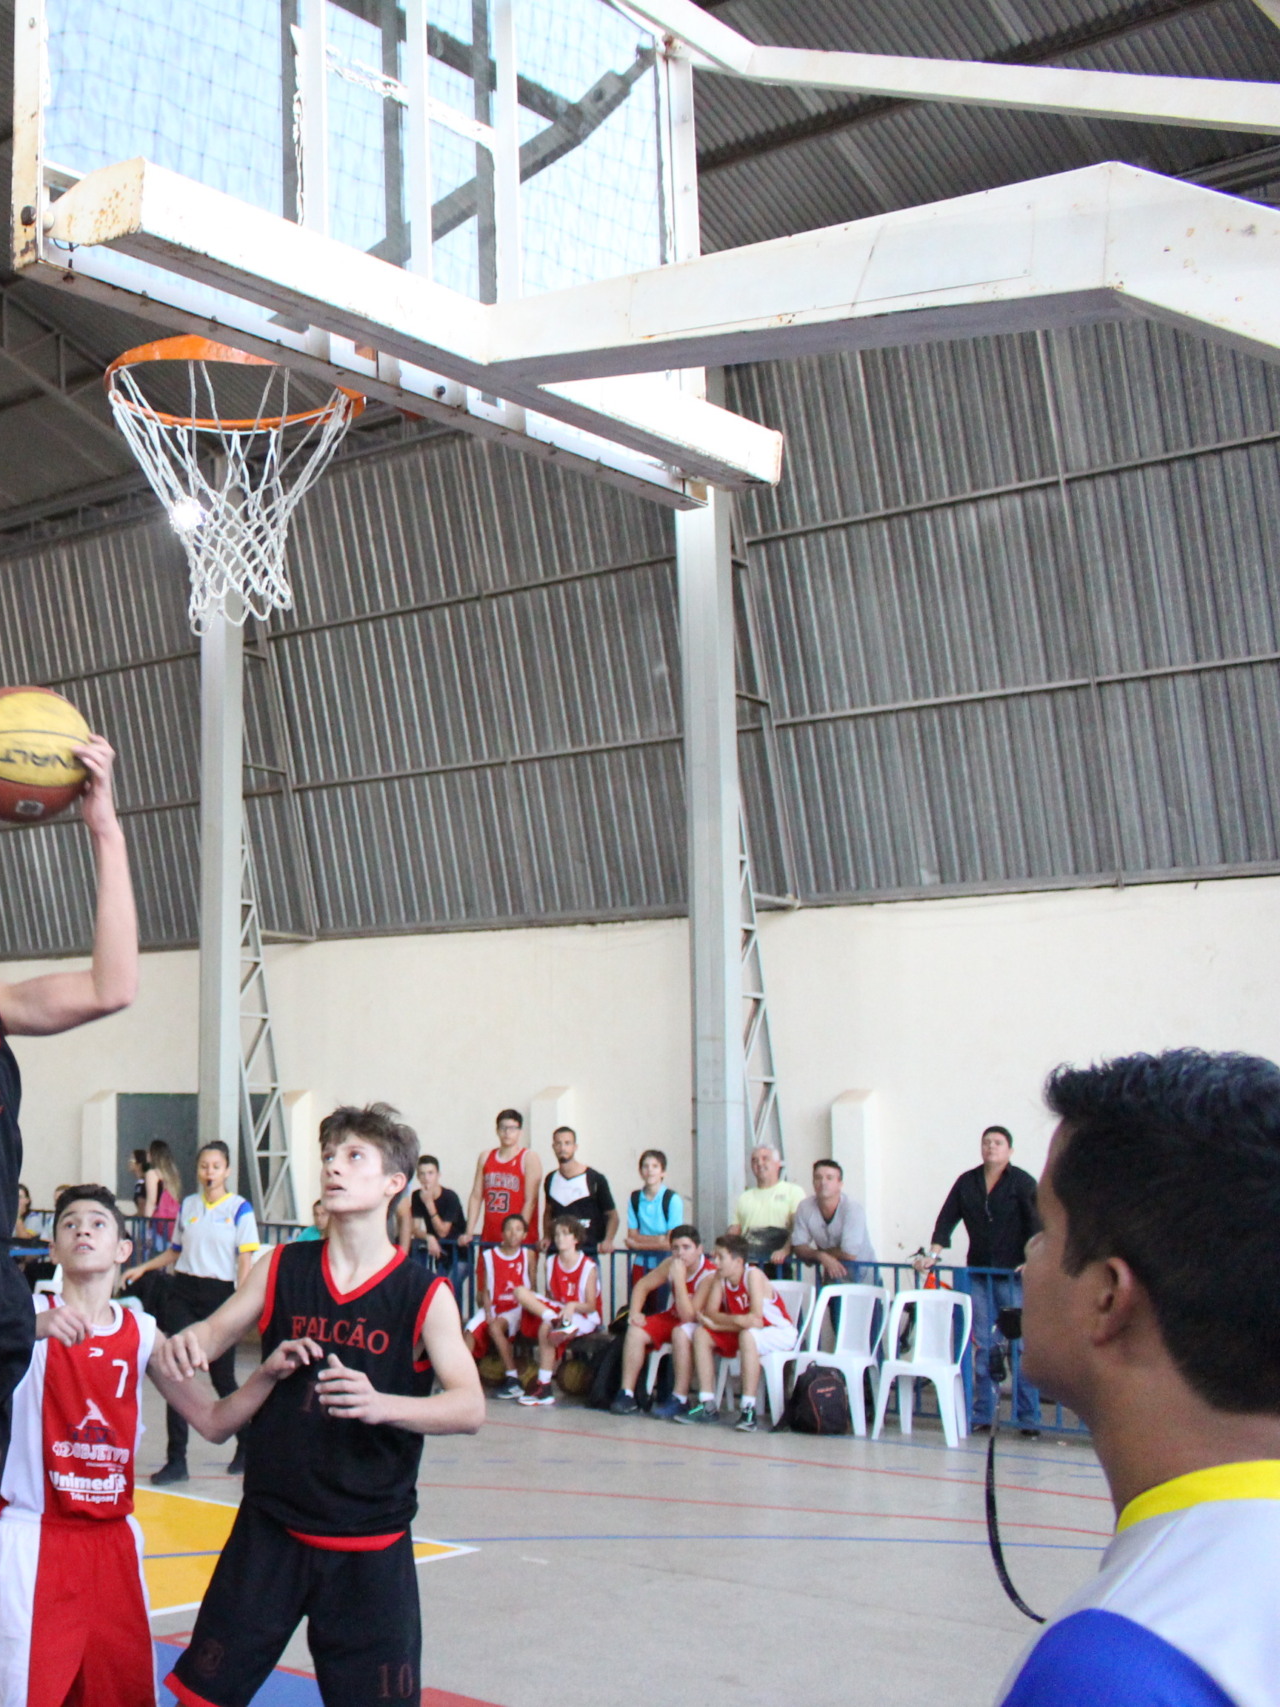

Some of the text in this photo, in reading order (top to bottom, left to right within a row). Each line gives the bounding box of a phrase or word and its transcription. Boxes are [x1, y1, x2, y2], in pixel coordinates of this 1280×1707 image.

[487, 1190, 510, 1213] 23
[290, 1315, 390, 1355] FALCÃO
[111, 1359, 129, 1399] 7
[48, 1470, 116, 1491] Unimed
[378, 1663, 414, 1698] 10
